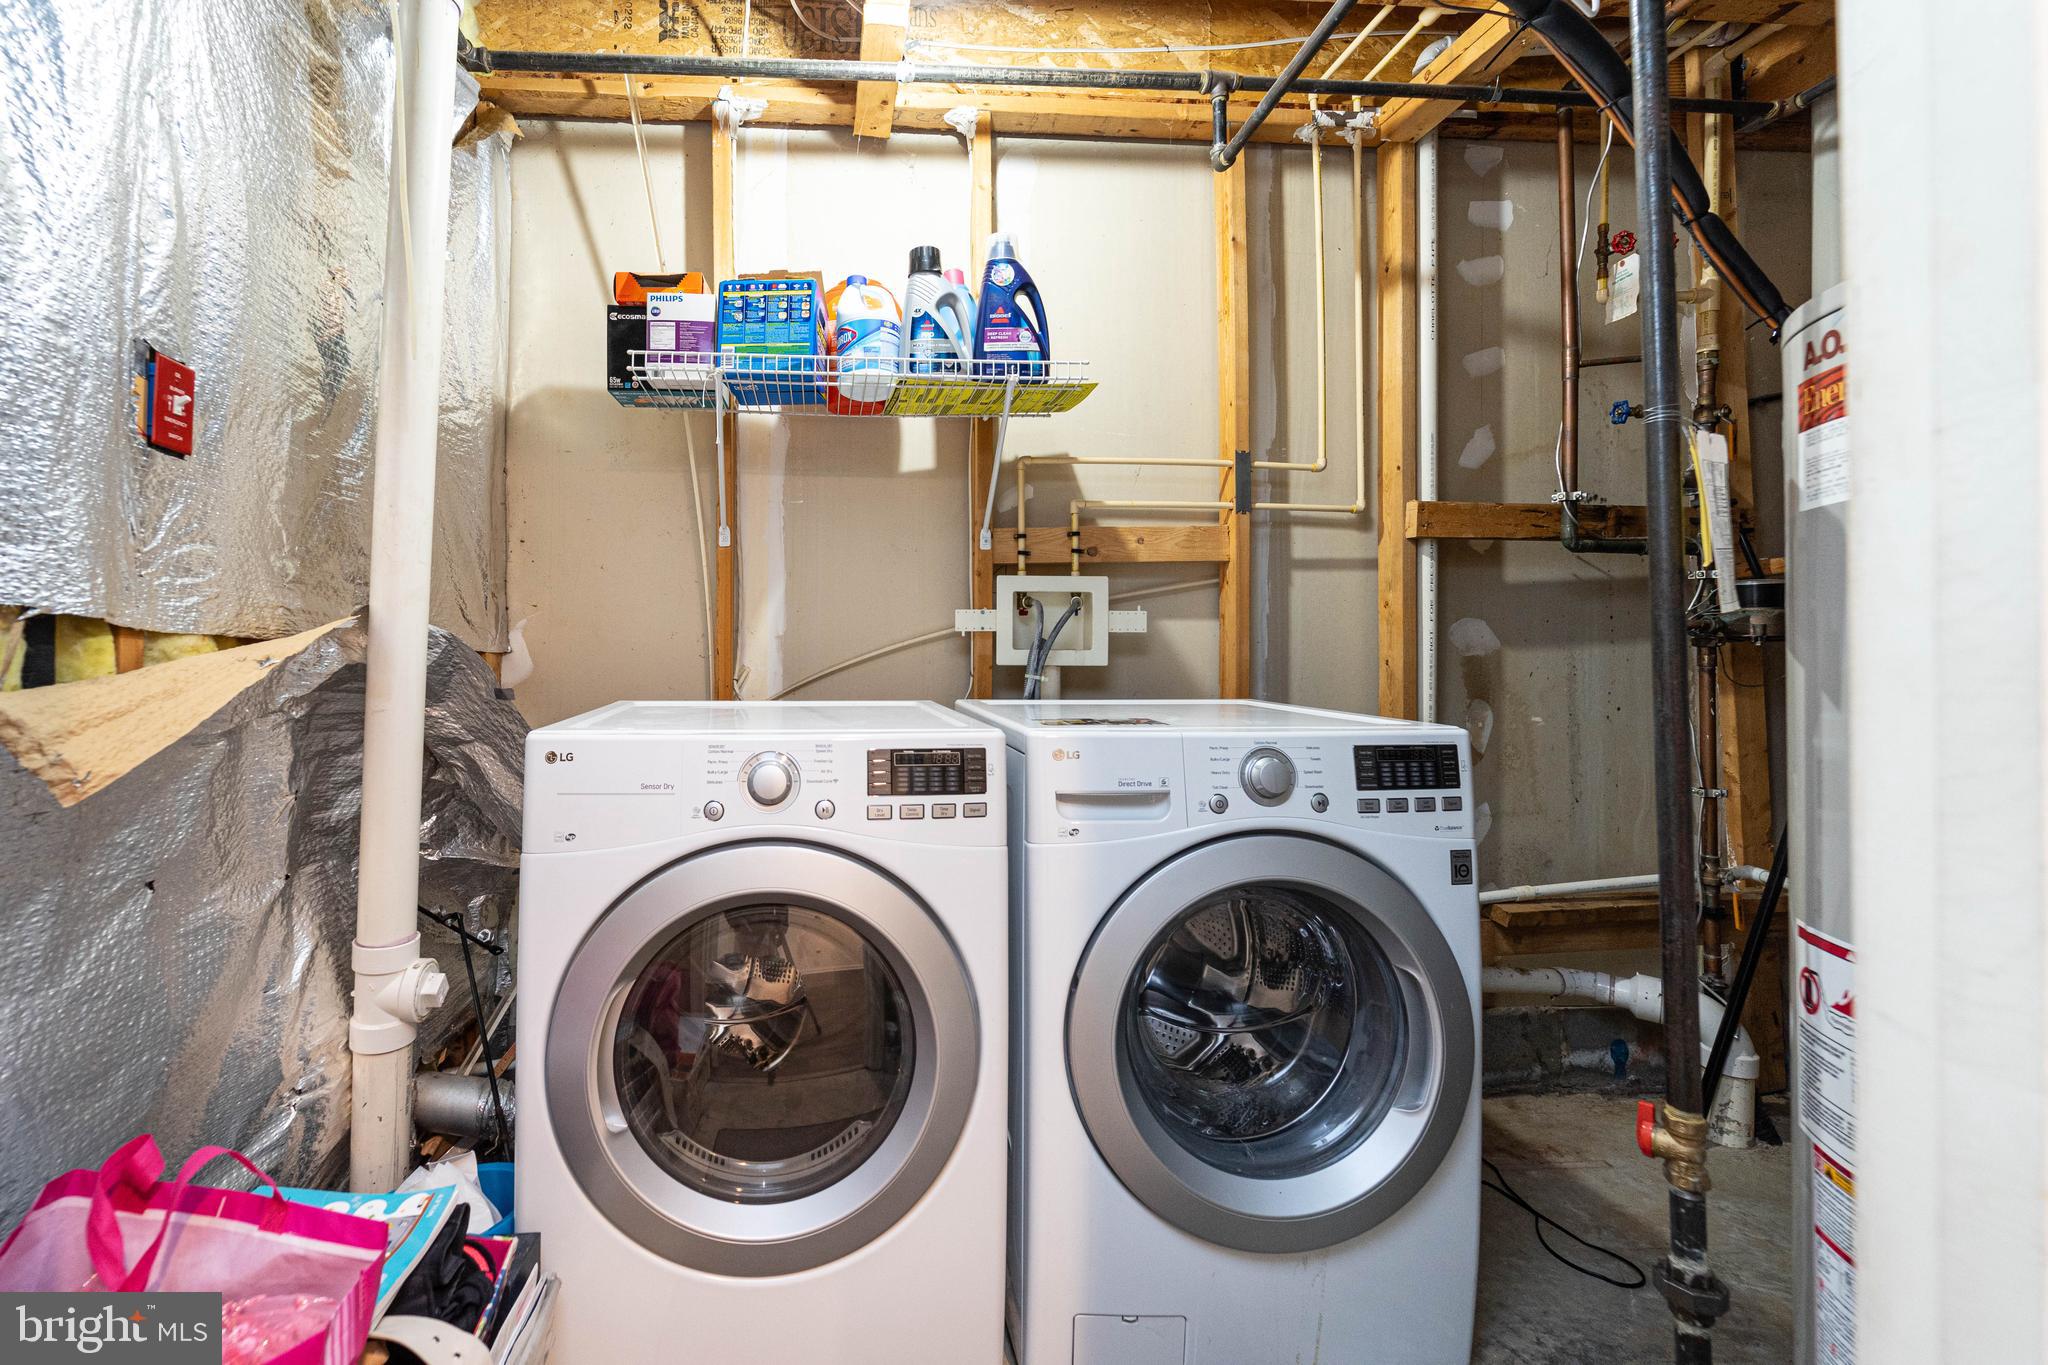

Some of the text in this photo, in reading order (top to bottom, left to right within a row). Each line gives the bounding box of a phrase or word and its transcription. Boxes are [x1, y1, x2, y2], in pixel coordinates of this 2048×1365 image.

[690, 5, 699, 38] CANADA
[910, 6, 938, 28] SUP
[682, 15, 690, 39] MADE
[560, 753, 574, 762] LG
[1066, 750, 1081, 760] LG
[640, 782, 675, 791] Sensor Dry
[1118, 780, 1153, 788] Direct Drive
